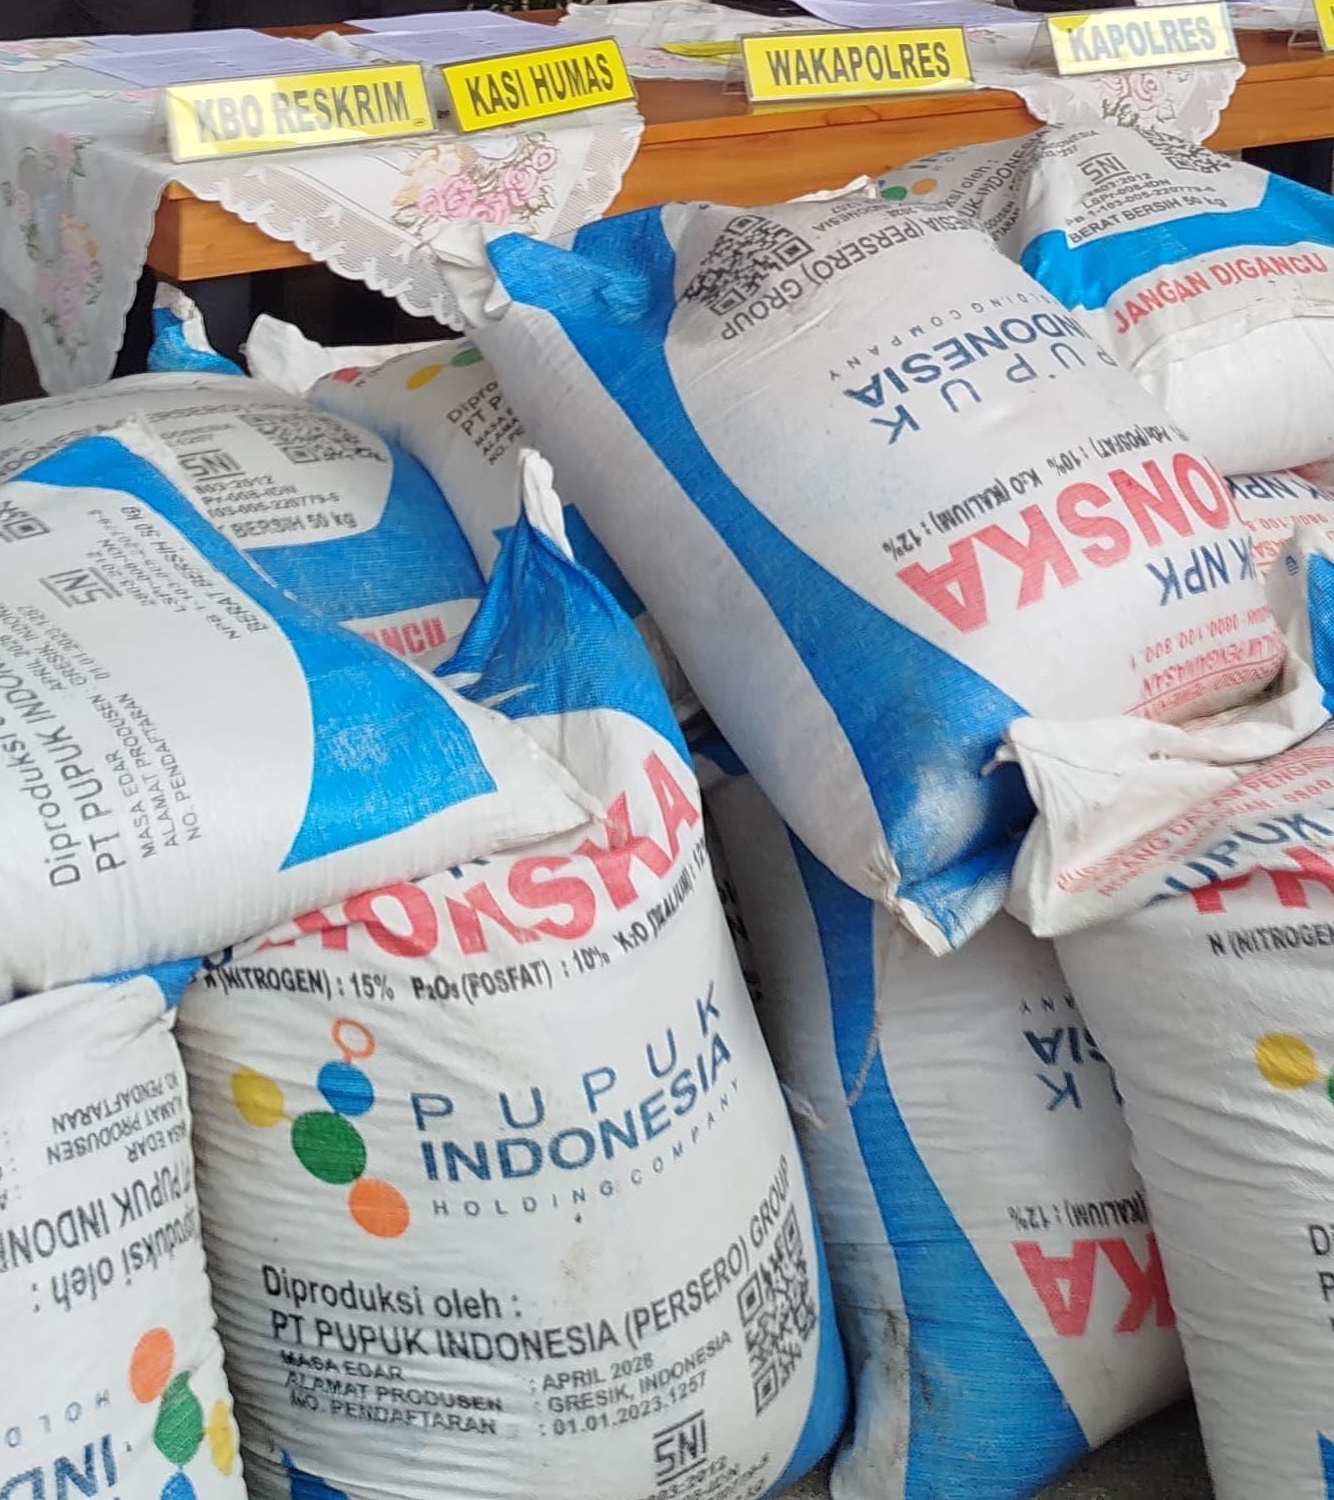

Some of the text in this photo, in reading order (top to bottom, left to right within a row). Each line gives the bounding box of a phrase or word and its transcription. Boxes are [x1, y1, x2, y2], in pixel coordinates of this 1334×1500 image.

[766, 39, 950, 88] WAKAPOLRES
[1070, 21, 1217, 67] KAPOLRES
[197, 78, 411, 142] KBO RESKRIM
[466, 52, 615, 118] KASI HUMAS
[1081, 153, 1129, 182] SNI
[1068, 195, 1199, 244] BERAT BERSIH 50
[720, 217, 922, 340] (PERSERO) GROUP
[1114, 252, 1328, 334] JANGAN DIGANCU
[828, 309, 961, 381] COMPANY
[178, 451, 242, 477] SNI
[231, 512, 358, 539] BERSIH 50 kg
[928, 473, 1010, 532] (KALIUM)
[893, 453, 1236, 634] ONSKA
[1144, 544, 1225, 607] NPK
[35, 724, 111, 821] PUPUK
[87, 694, 179, 847] ALAMAT PRODUSEN
[116, 693, 191, 802] PENDAFTARAN
[105, 750, 156, 858] MASA EDAR
[88, 833, 125, 872] PT
[349, 974, 393, 1001] 15%
[409, 981, 722, 1131] PUPUK
[50, 1077, 164, 1134] PENDAFTARAN
[420, 1034, 732, 1182] INDONESIA
[46, 1110, 140, 1165] PRODUSEN
[432, 1078, 742, 1218] HOLDING COMPANY
[1006, 1204, 1051, 1231] 12%
[49, 1255, 114, 1311] oleh
[270, 1154, 793, 1362] PT PUPUK INDONESIA (PERSERO) GROUP
[262, 1263, 503, 1321] Diproduksi oleh
[331, 1370, 707, 1437] PENDAFTARAN 01.01.2023.1257
[345, 1361, 403, 1381] EDAR
[543, 1368, 603, 1392] APRIL
[377, 1385, 502, 1411] PRODUSEN
[548, 1383, 635, 1414] GRESIK,
[639, 1331, 732, 1394] INDONESIA
[655, 1421, 708, 1468] SNI
